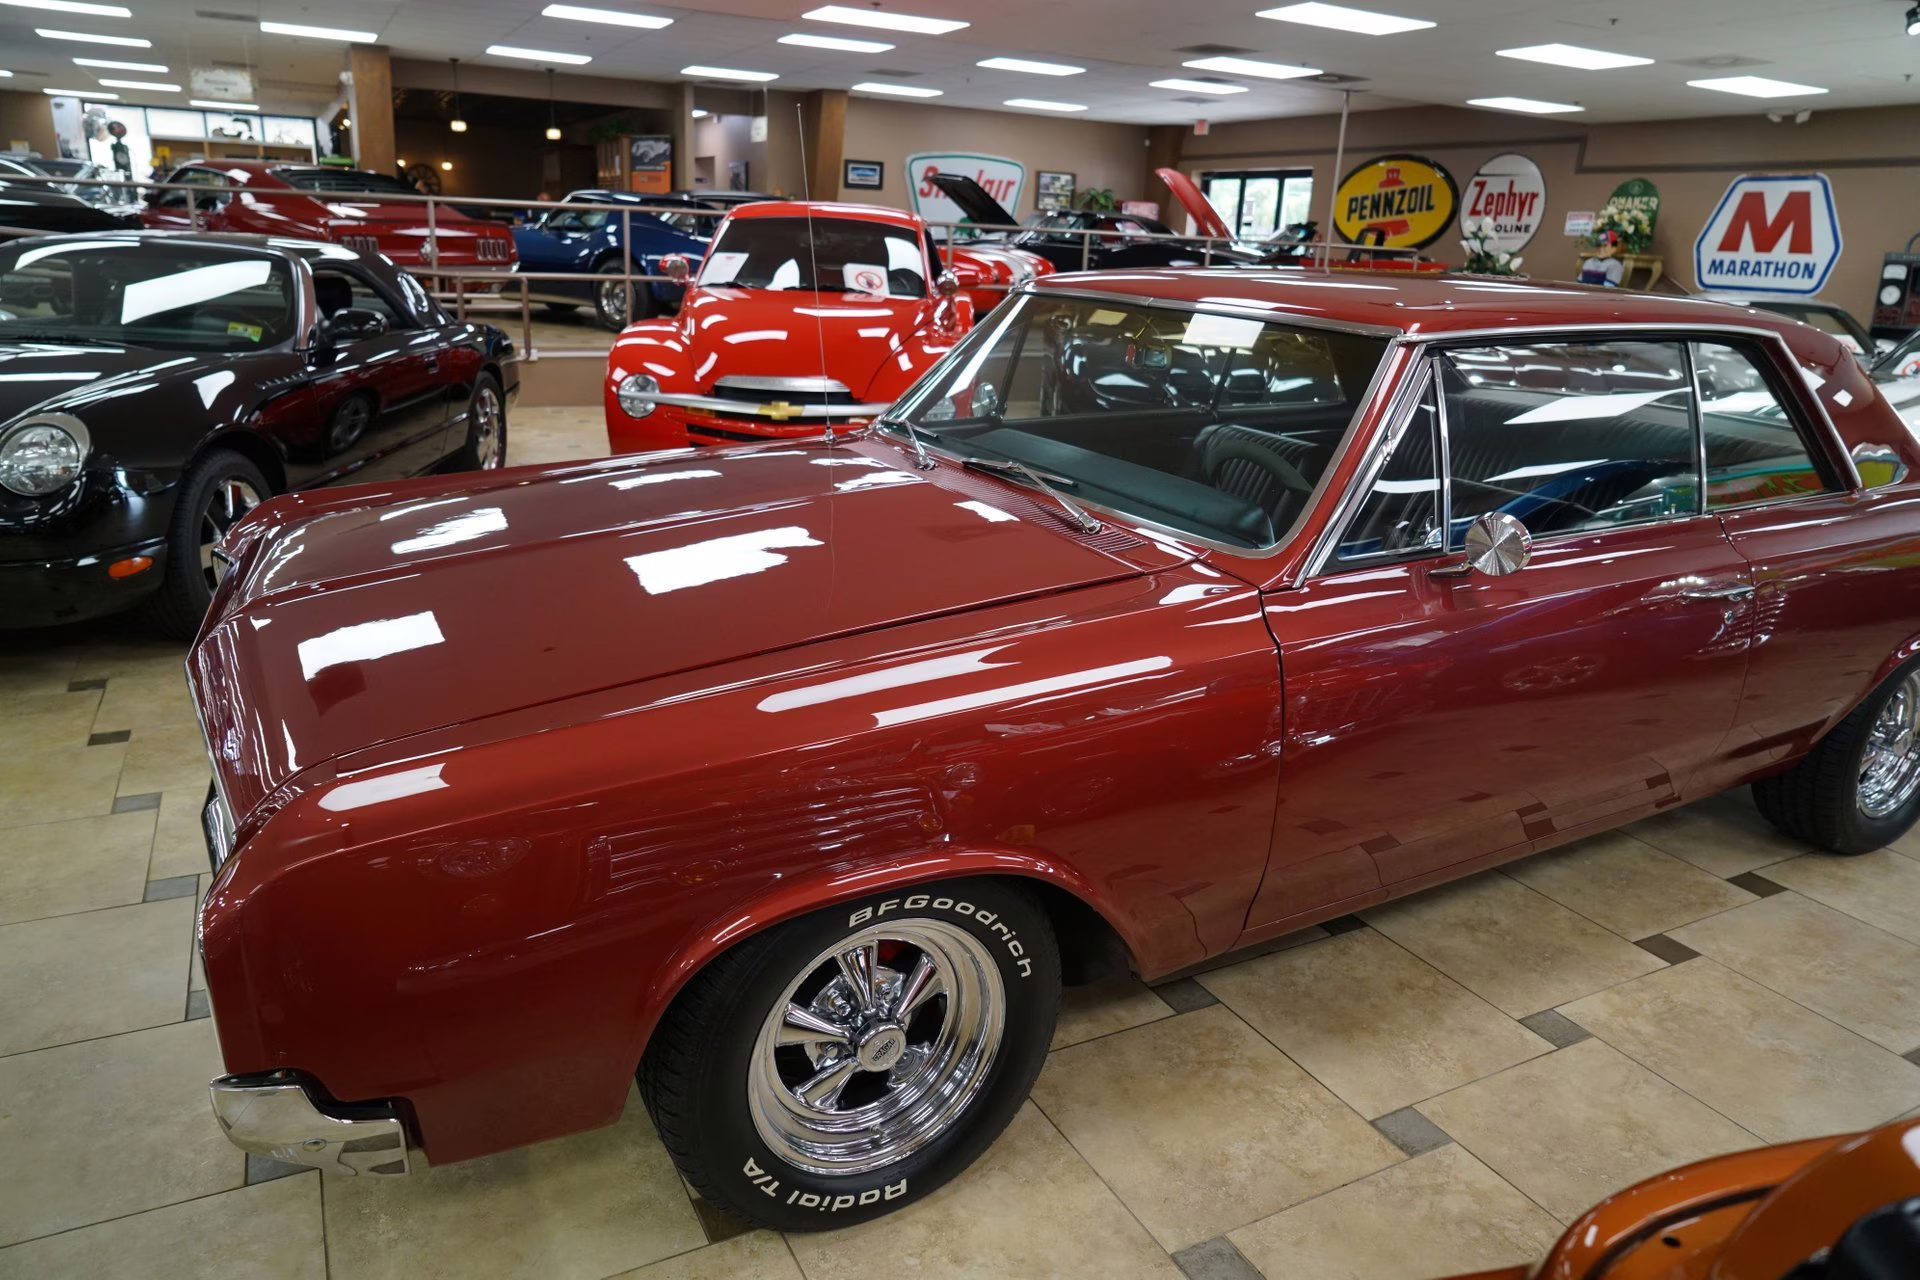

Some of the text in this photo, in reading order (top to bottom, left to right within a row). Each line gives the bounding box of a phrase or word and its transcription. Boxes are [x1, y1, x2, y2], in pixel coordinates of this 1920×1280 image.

[919, 165, 1016, 202] Slair
[1346, 184, 1435, 222] PENNZOIL
[1468, 179, 1539, 222] Zephyr
[1716, 191, 1813, 254] M
[1707, 259, 1816, 279] MARATHON
[848, 895, 1033, 978] BFGoodrich
[742, 1157, 907, 1212] Radial T/A
